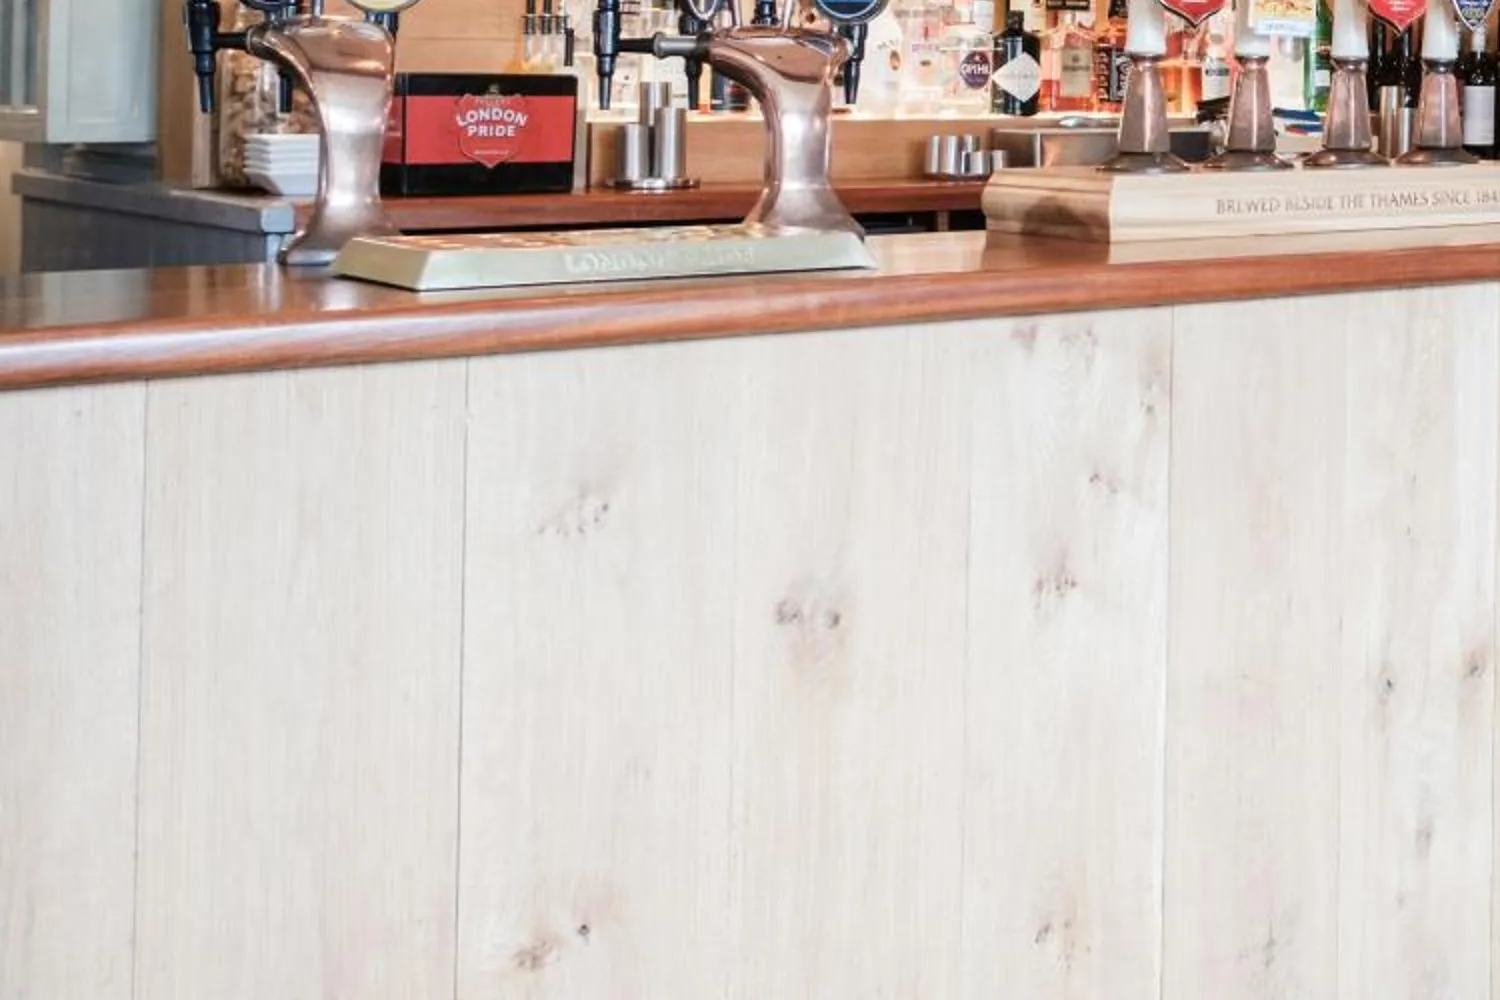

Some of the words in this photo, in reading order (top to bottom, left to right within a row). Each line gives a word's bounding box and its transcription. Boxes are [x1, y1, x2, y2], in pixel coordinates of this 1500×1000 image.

[455, 107, 530, 128] LONDON
[467, 124, 517, 138] PRIDE
[1216, 197, 1281, 215] BREWED
[1339, 192, 1366, 209] THE
[1369, 191, 1429, 208] THAMES
[1430, 189, 1469, 206] SINCE
